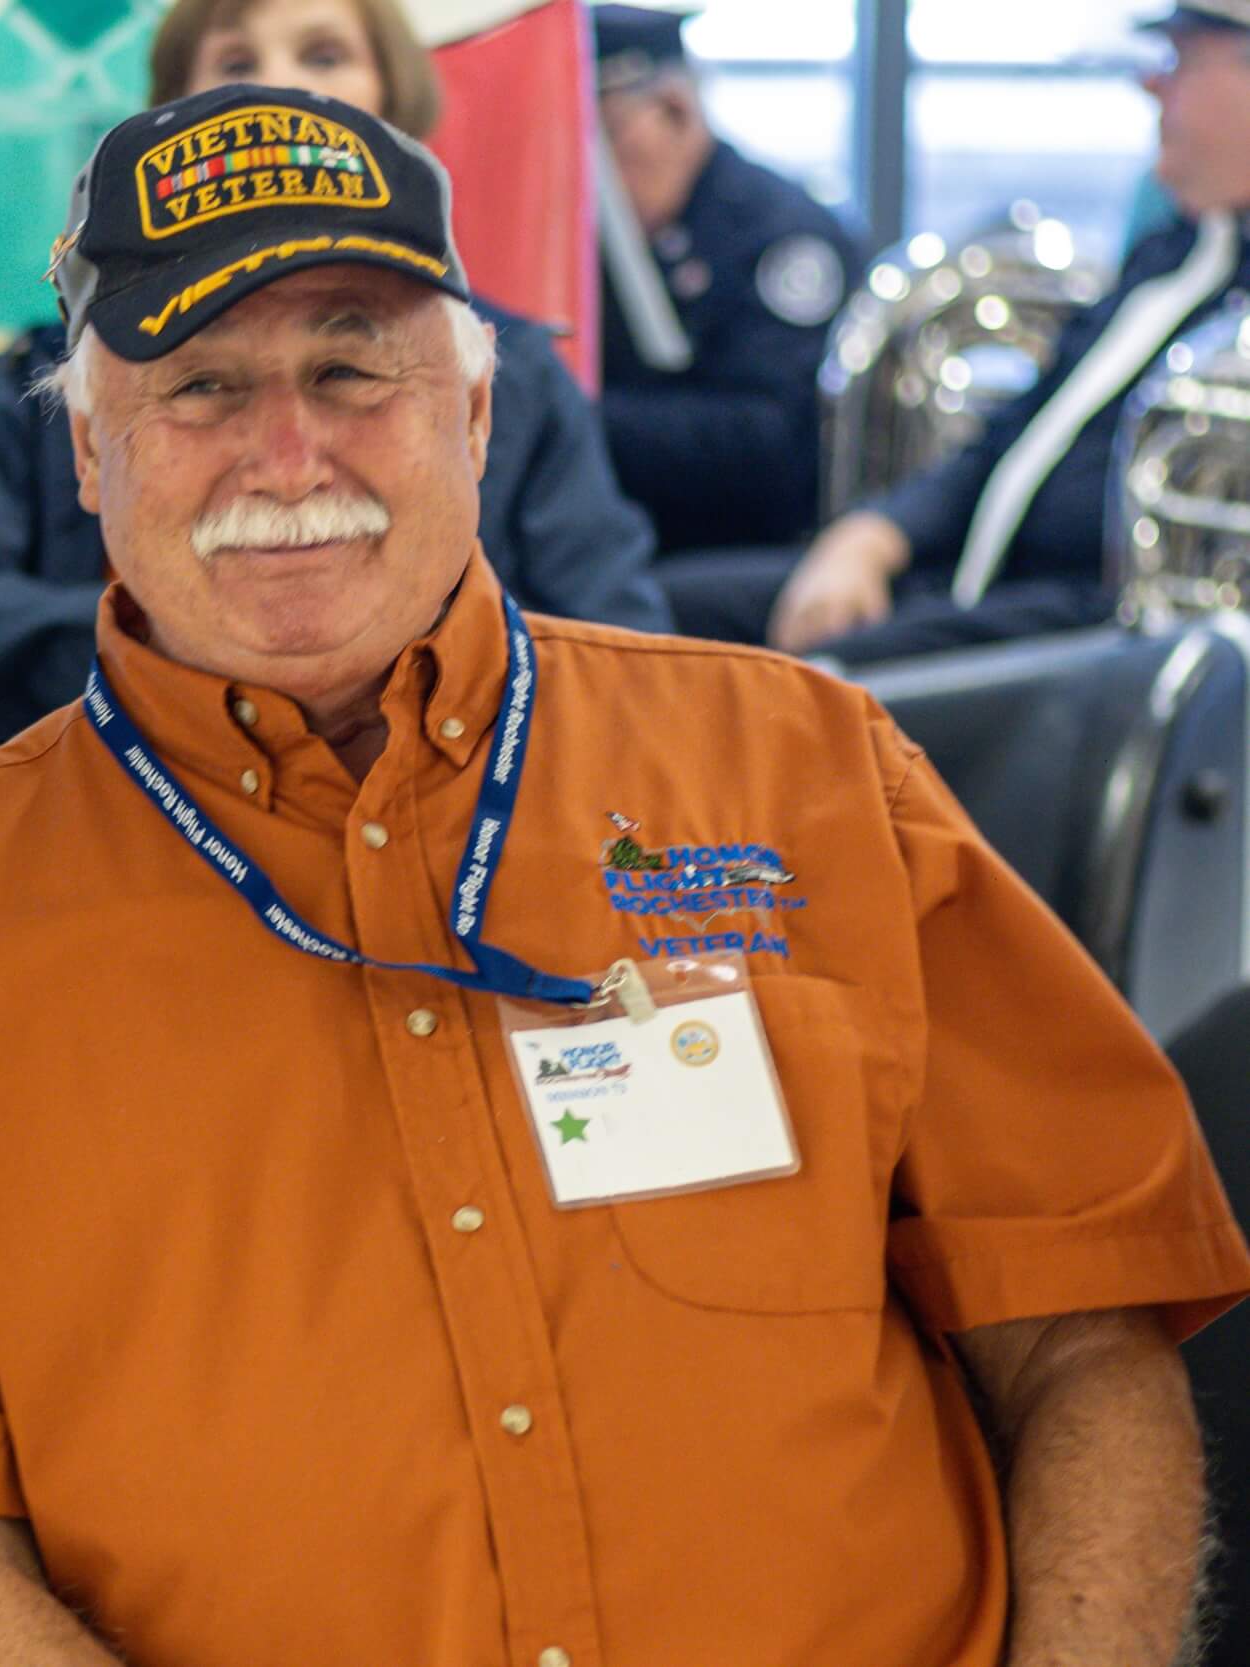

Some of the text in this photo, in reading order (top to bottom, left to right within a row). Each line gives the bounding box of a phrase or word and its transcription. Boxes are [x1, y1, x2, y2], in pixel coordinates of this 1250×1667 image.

[149, 112, 361, 175] VIETNAM
[165, 168, 365, 222] VETERAN
[124, 744, 249, 884] Honor Flight Rochester
[472, 817, 501, 865] Honor
[666, 844, 785, 872] HONOR
[457, 863, 489, 914] Flight
[604, 866, 727, 892] FLIGHT
[610, 887, 776, 916] ROCHESTER
[637, 930, 790, 960] VETERAN
